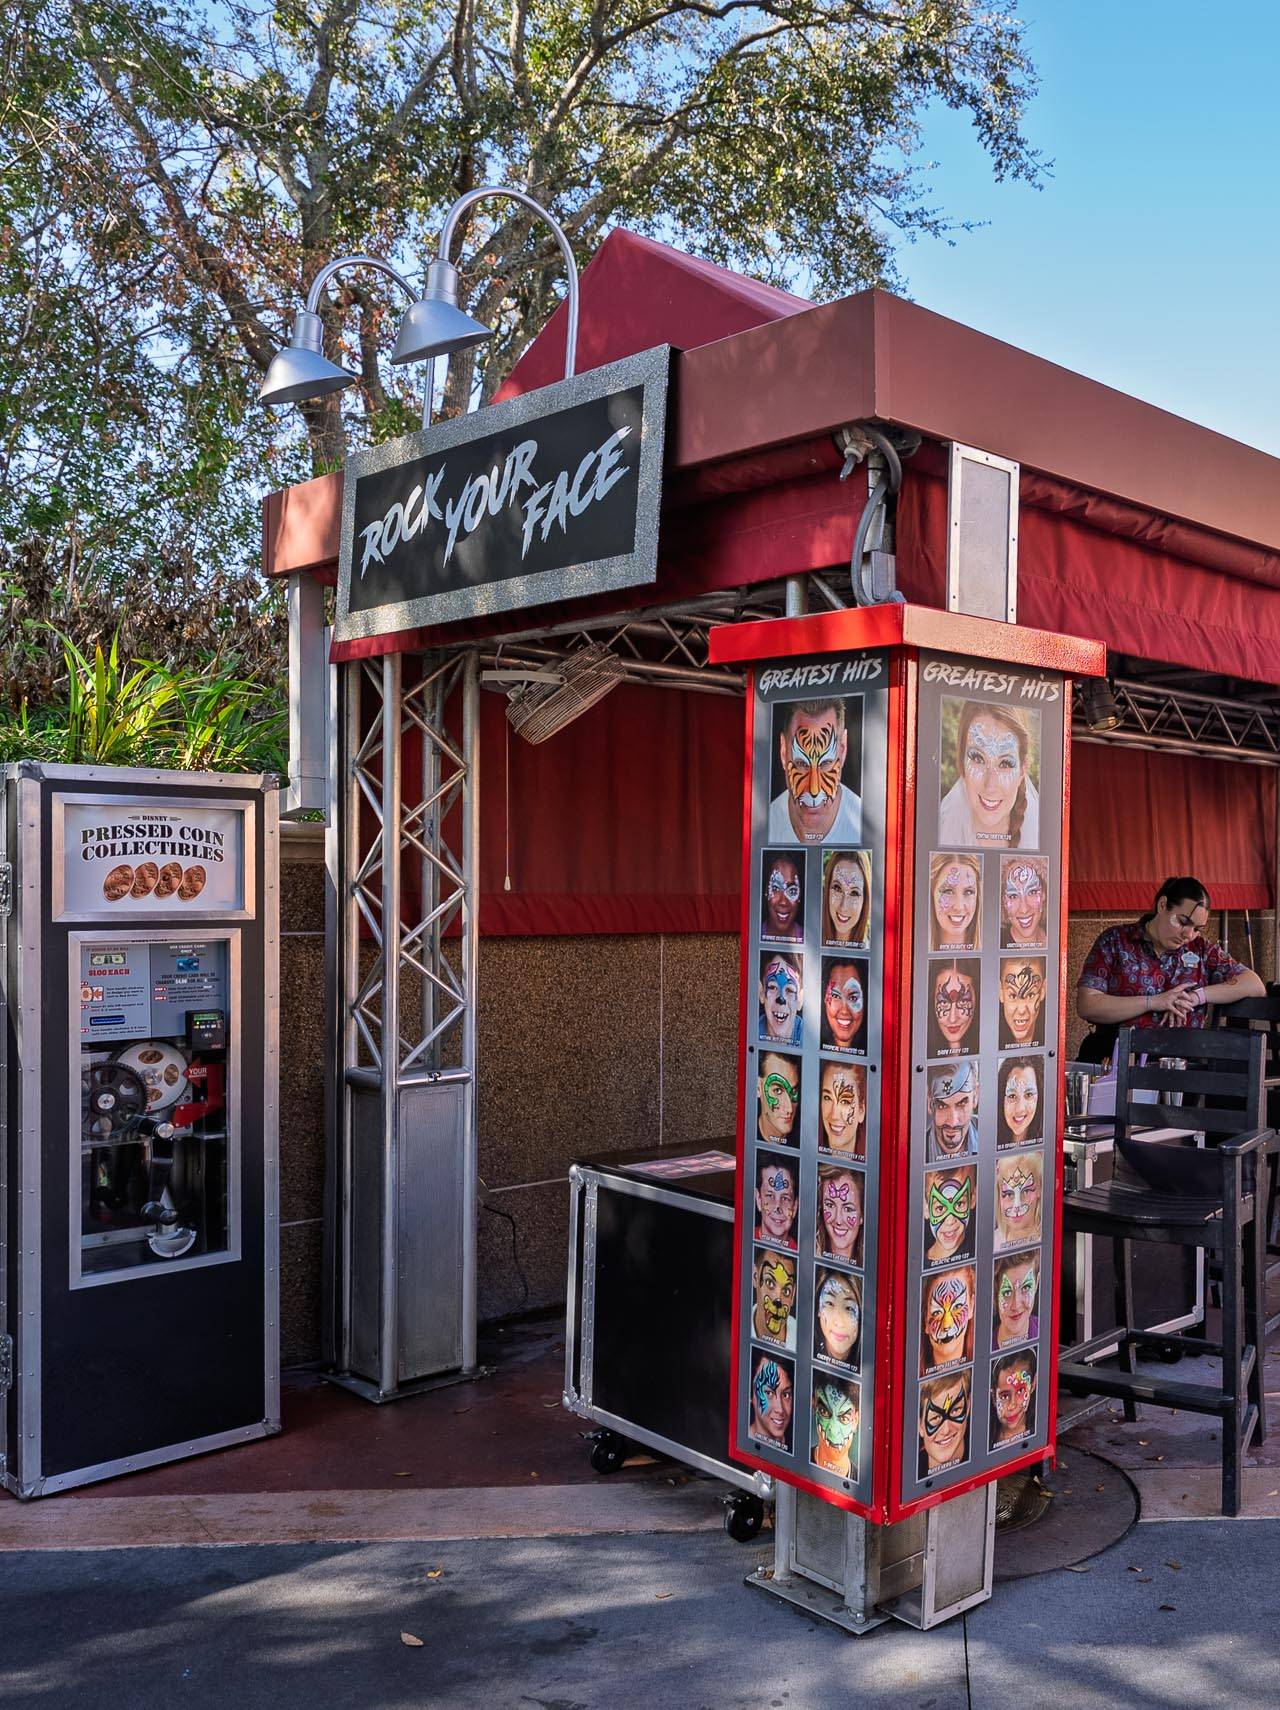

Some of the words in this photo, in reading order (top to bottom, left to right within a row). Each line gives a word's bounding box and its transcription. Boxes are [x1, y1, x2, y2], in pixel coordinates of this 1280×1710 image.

[358, 462, 446, 580] ROCK
[443, 440, 539, 568] YOUR
[521, 425, 633, 560] FACE
[760, 662, 842, 695] GREATEST
[923, 661, 1021, 695] GREATEST
[81, 824, 173, 844] PRESSED
[179, 826, 225, 847] COIN
[82, 841, 224, 863] COLLECTIBLES
[188, 1067, 208, 1076] YOUR
